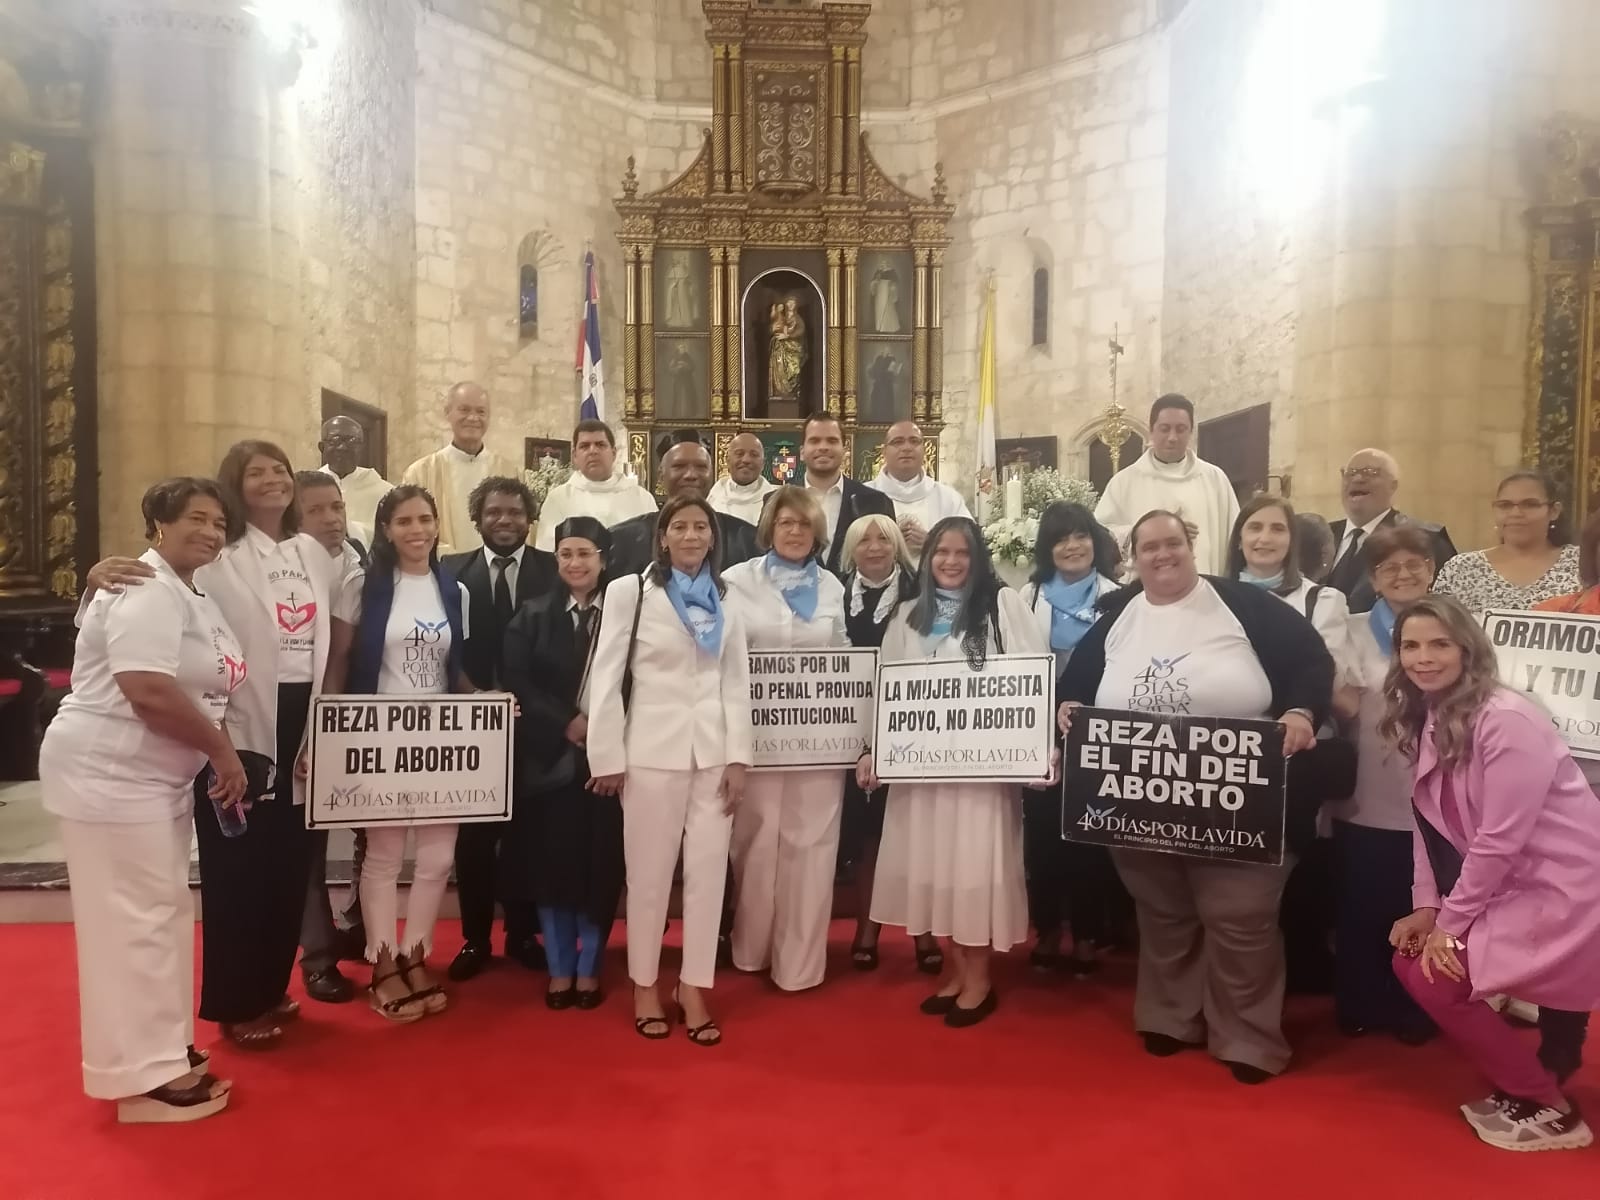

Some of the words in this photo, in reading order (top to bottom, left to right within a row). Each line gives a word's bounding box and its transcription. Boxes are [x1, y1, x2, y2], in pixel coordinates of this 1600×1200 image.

[403, 626, 440, 647] 40
[402, 662, 428, 674] POR
[749, 656, 795, 674] RAMOS
[800, 656, 827, 673] POR
[832, 656, 850, 673] UN
[1134, 665, 1174, 683] 40
[768, 682, 812, 700] PENAL
[816, 681, 873, 699] PROVIDA
[885, 680, 901, 702] LA
[906, 678, 961, 701] MUJER
[967, 674, 1042, 698] NECESITA
[1132, 678, 1189, 697] DÍAS
[1525, 664, 1543, 693] Y
[1551, 667, 1586, 698] TU
[1128, 695, 1165, 709] POR
[1170, 692, 1192, 703] LA
[321, 705, 379, 733] REZA
[387, 704, 431, 732] POR
[439, 705, 463, 731] EL
[471, 705, 503, 731] FIN
[752, 706, 858, 726] ONSTITUCIONAL
[888, 710, 941, 734] APOYO,
[946, 709, 967, 731] NO
[972, 706, 1036, 730] ABORTO
[754, 736, 779, 752] ÍAS
[1088, 718, 1178, 749] REZA
[1188, 726, 1263, 757] POR
[345, 747, 386, 774] DEL
[394, 745, 480, 773] ABORTO
[883, 749, 905, 767] 40
[1080, 744, 1120, 772] EL
[1131, 749, 1188, 778] FIN
[1200, 755, 1269, 786] DEL
[323, 789, 350, 811] 40
[1098, 774, 1245, 811] ABORTO
[1076, 810, 1104, 831] 40
[1106, 812, 1148, 831] DÍAS
[1150, 821, 1190, 840] POR
[1124, 834, 1158, 844] PRINCIPIO
[1160, 838, 1174, 846] DEL
[1174, 840, 1187, 848] FIN
[1188, 842, 1202, 850] DEL
[1204, 844, 1235, 854] ABORTO
